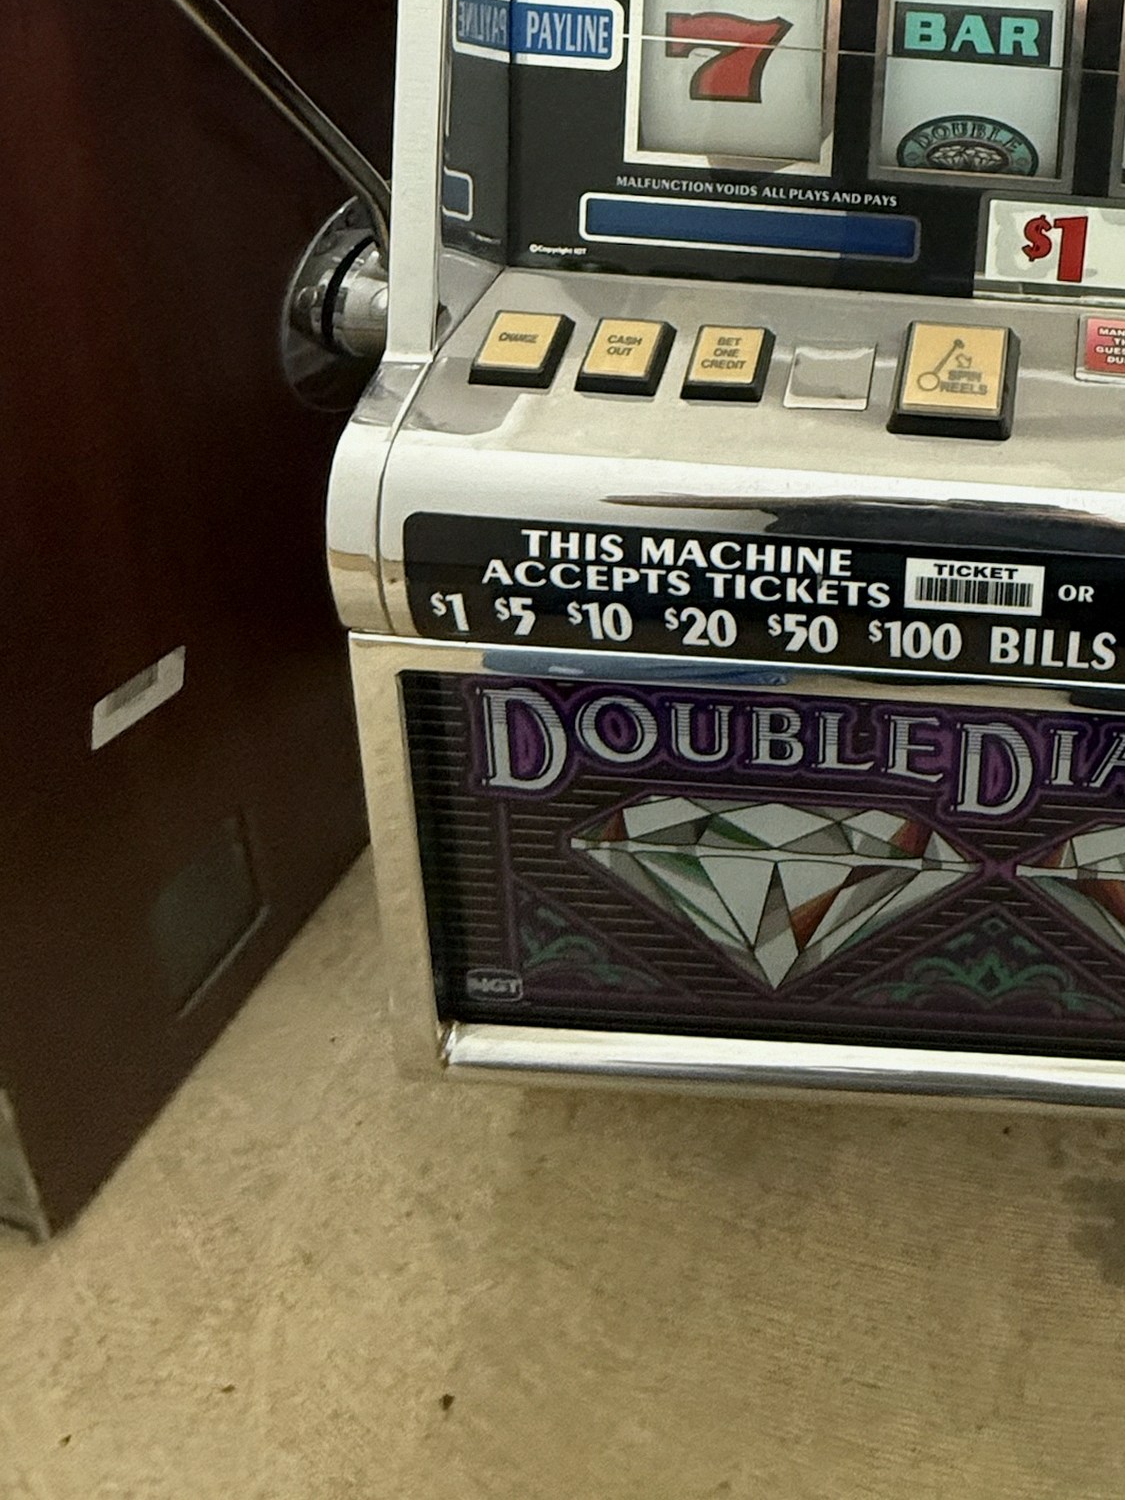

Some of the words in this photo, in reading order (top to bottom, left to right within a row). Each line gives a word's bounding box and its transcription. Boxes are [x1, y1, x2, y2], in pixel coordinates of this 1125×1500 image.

[526, 10, 609, 54] PAYLINE
[904, 11, 1040, 57] BAR
[666, 11, 794, 104] 7
[913, 122, 1023, 154] DOUBLE
[616, 175, 713, 193] MALFUNCTION
[716, 183, 758, 197] VOIDS
[762, 186, 787, 199] ALL
[792, 188, 830, 202] PLAYS
[832, 192, 862, 204] AND
[864, 194, 897, 207] PAYS
[1021, 214, 1089, 283] $1
[606, 346, 633, 357] OUT
[607, 334, 642, 346] CASH
[713, 348, 739, 358] ONE
[716, 337, 742, 347] BET
[701, 359, 747, 370] CREDIT
[940, 381, 988, 395] REELS
[521, 528, 625, 564] THIS
[639, 536, 853, 578] MACHINE
[481, 559, 692, 598] ACCEPTS
[704, 571, 892, 610] TICKETS
[933, 563, 1019, 582] TICKET
[1057, 583, 1095, 604] OR
[429, 592, 470, 633] $1
[494, 595, 536, 638] $5
[567, 600, 633, 645] $10
[663, 606, 738, 650] $20
[768, 611, 839, 656] $50
[867, 618, 963, 662] $100
[990, 625, 1117, 672] BILLS
